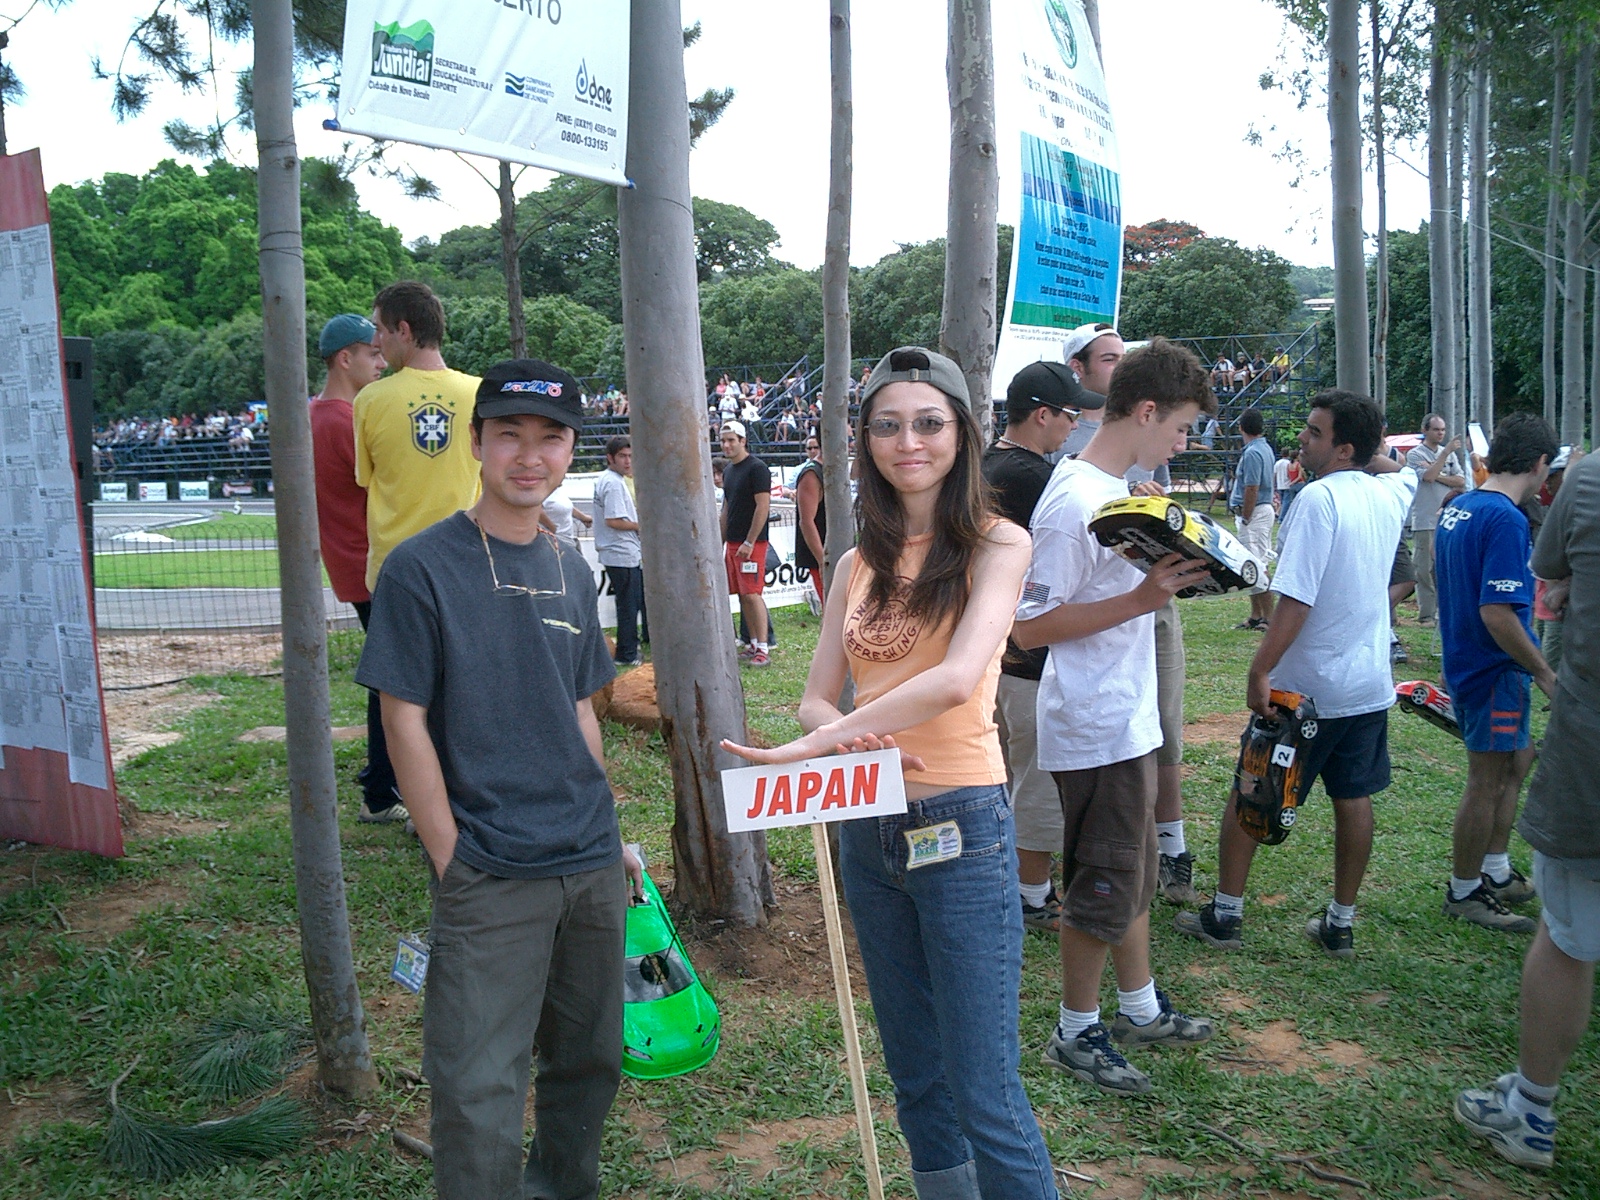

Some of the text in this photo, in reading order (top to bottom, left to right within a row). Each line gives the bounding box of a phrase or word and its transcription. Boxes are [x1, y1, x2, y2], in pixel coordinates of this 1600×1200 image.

[374, 44, 432, 82] Jundiaí
[435, 57, 477, 76] SECRETARIA DE
[432, 80, 457, 94] ESPORTE
[561, 130, 609, 152] 0800-133155
[1487, 580, 1523, 588] NITRO
[863, 622, 900, 634] FRESH
[844, 626, 917, 660] REFRESHING
[1278, 751, 1291, 763] 2
[746, 763, 880, 820] JAPAN
